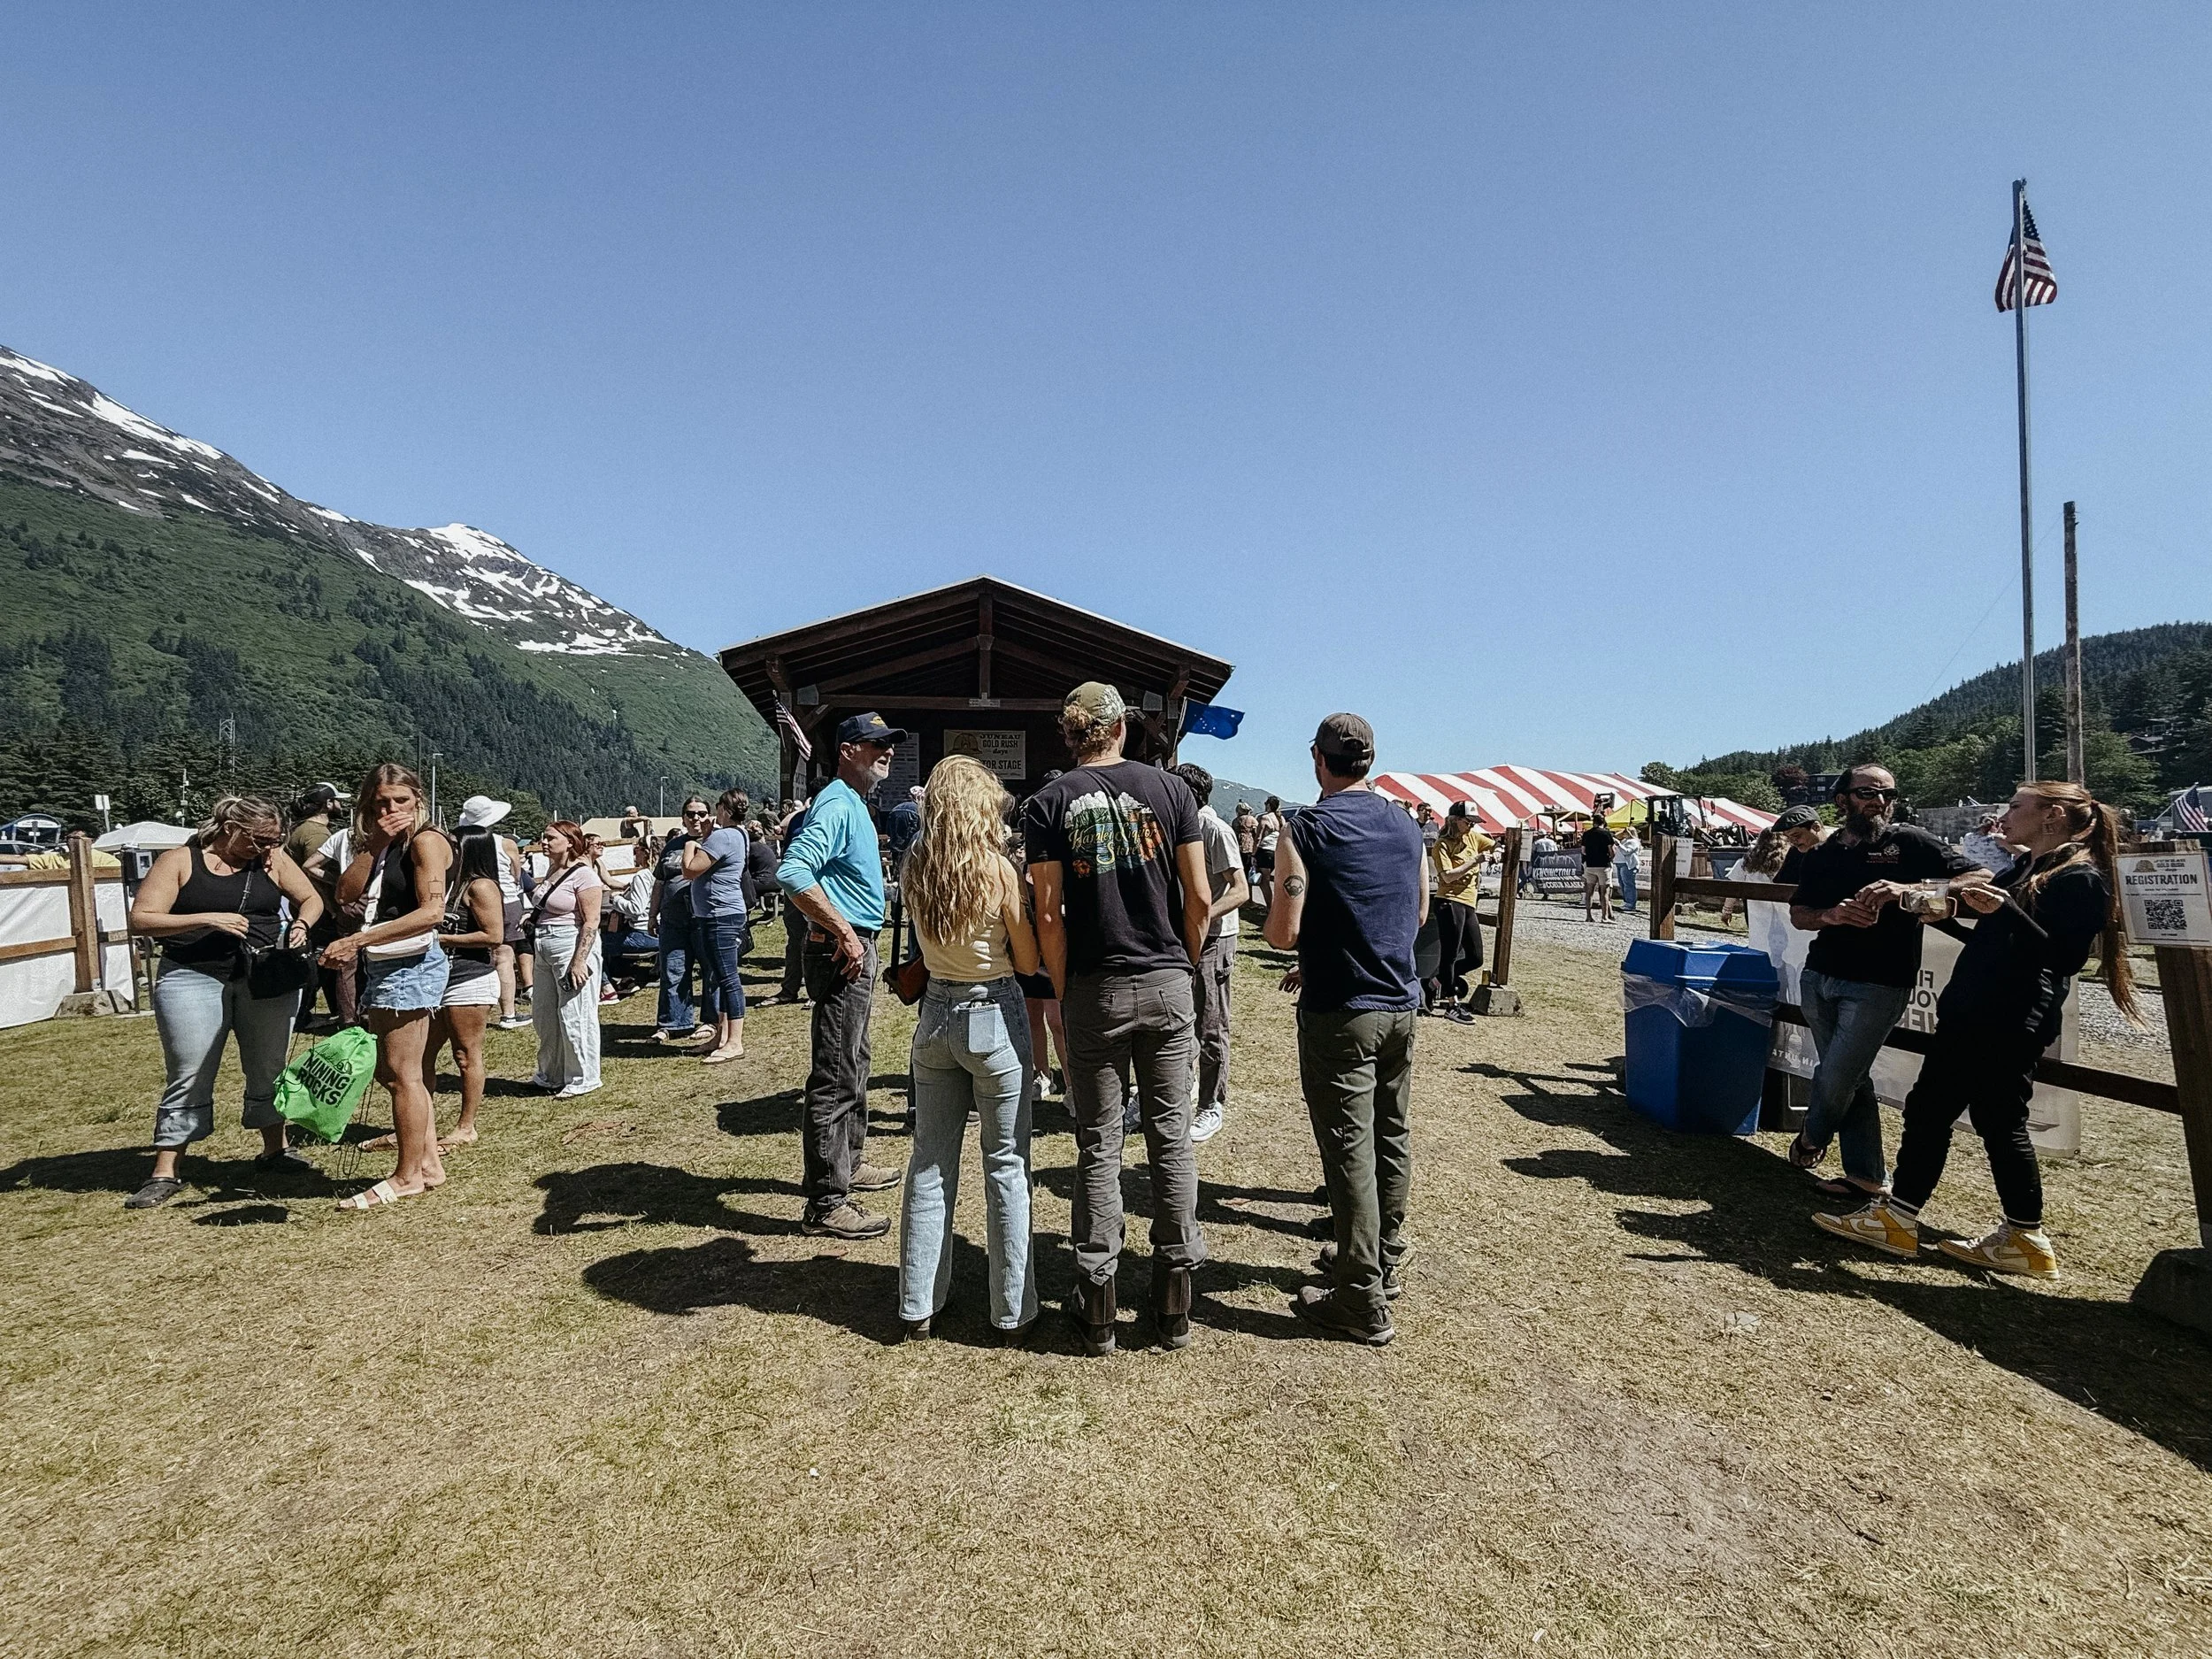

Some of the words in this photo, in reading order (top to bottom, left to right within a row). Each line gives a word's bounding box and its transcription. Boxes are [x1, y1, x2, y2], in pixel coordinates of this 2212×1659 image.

[982, 740, 999, 749] GOLD
[1001, 740, 1018, 749] RUSH
[998, 760, 1022, 770] STAGE
[2125, 874, 2198, 885] REGISTRATION
[303, 1052, 350, 1090] MINING
[296, 1067, 342, 1105] ROCKS
